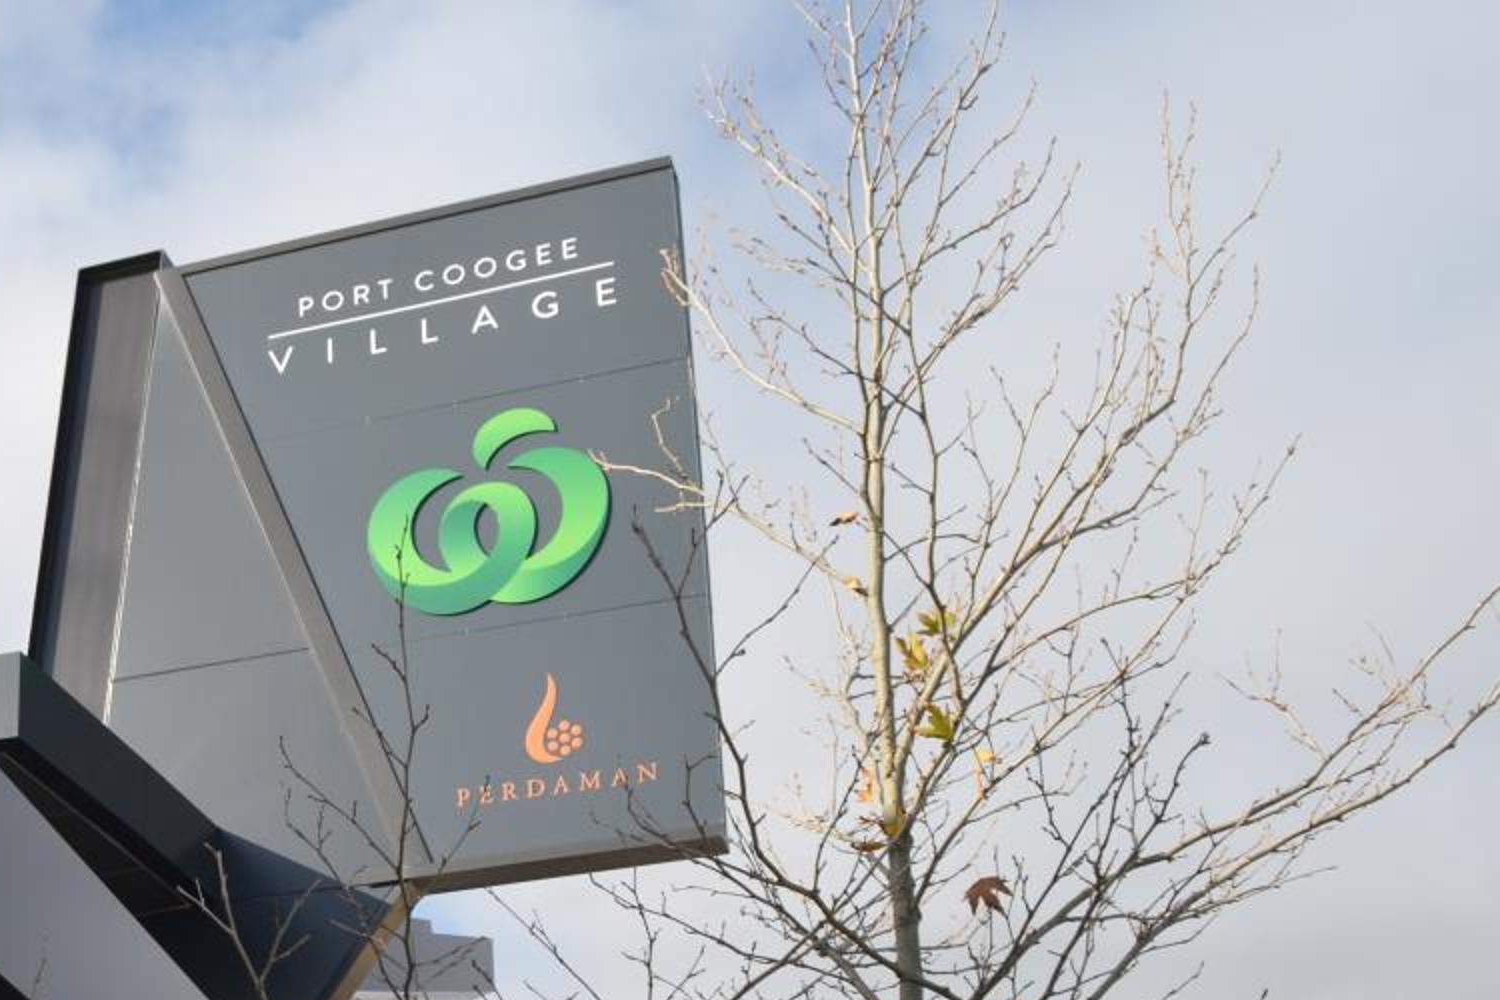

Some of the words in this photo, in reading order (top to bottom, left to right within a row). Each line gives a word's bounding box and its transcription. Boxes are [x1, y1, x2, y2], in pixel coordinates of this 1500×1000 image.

[298, 277, 394, 318] PORT
[413, 237, 579, 292] COOGEE
[268, 276, 618, 375] VILLAGE
[456, 761, 659, 808] PERDAMAN
